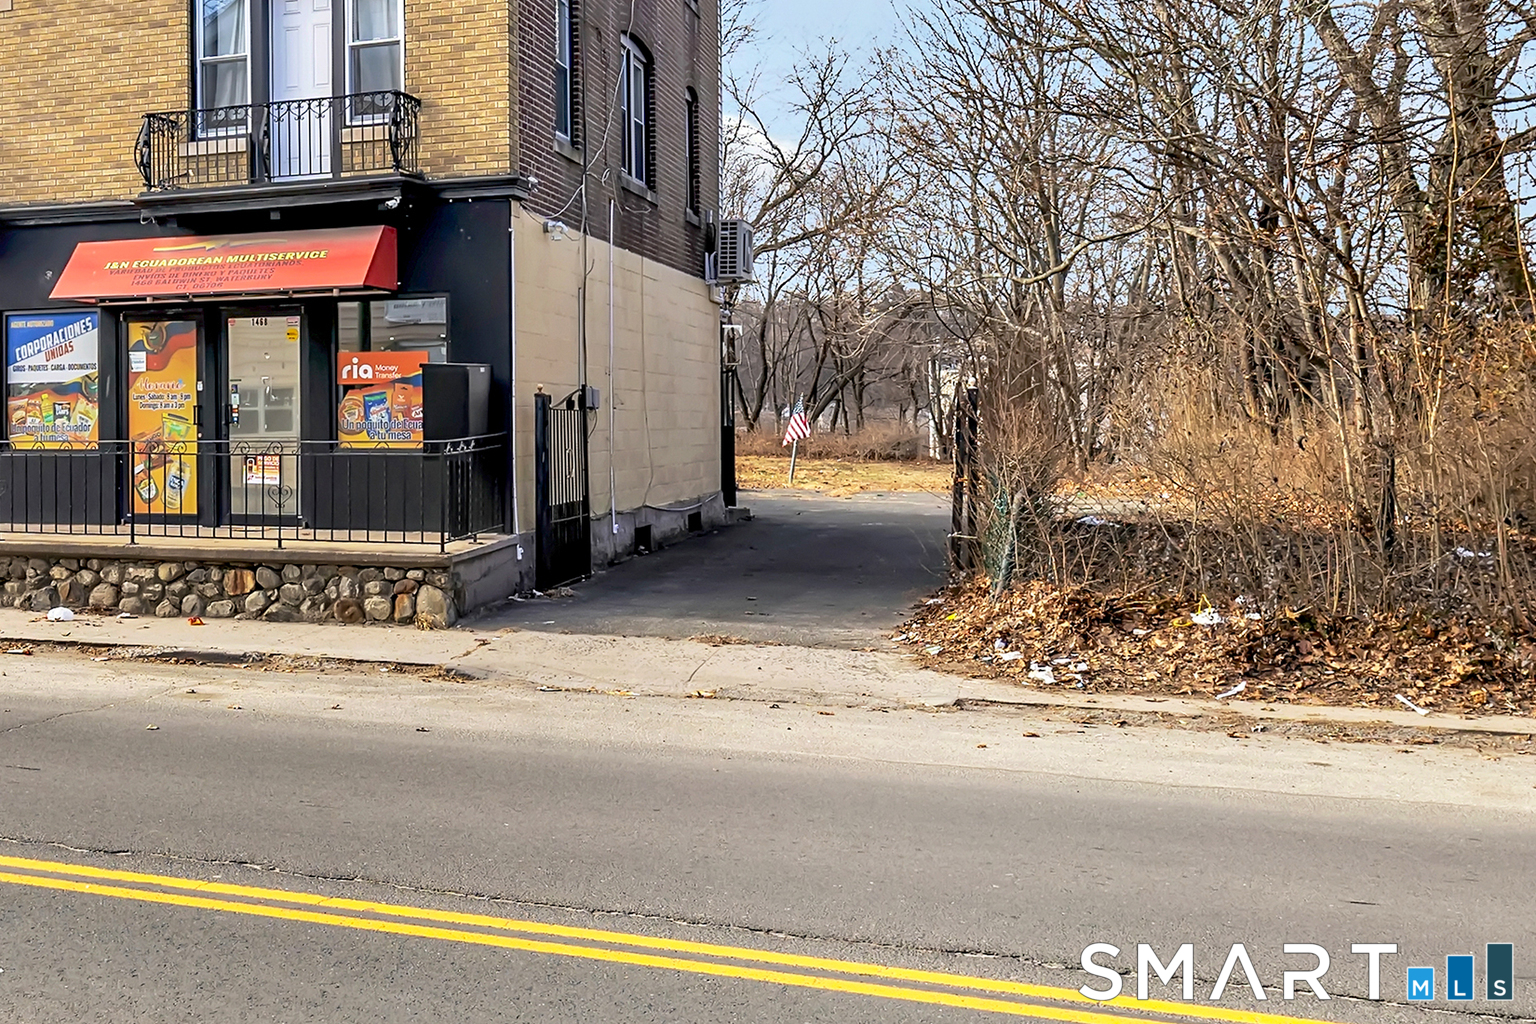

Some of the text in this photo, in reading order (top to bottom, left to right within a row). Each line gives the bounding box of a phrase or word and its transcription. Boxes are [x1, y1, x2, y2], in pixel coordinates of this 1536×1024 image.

[104, 250, 329, 270] J&N ECUADOREAN MULTISERVICE
[169, 263, 227, 272] PRODUCTOS
[228, 267, 276, 275] PAQUETES
[216, 273, 273, 282] WATERBURY
[15, 316, 93, 362] CORPORACIONES
[44, 340, 74, 362] UNIDAS
[12, 362, 97, 372] GIROS PAQUETES CARGA DOCUMENTOS
[342, 356, 373, 379] ria
[374, 364, 399, 372] Money
[375, 371, 402, 379] Transfer
[62, 422, 91, 432] Ecuador
[342, 419, 355, 430] Un
[356, 420, 389, 431] poquito
[390, 419, 402, 429] de
[377, 431, 386, 440] tu
[387, 432, 412, 440] mesa
